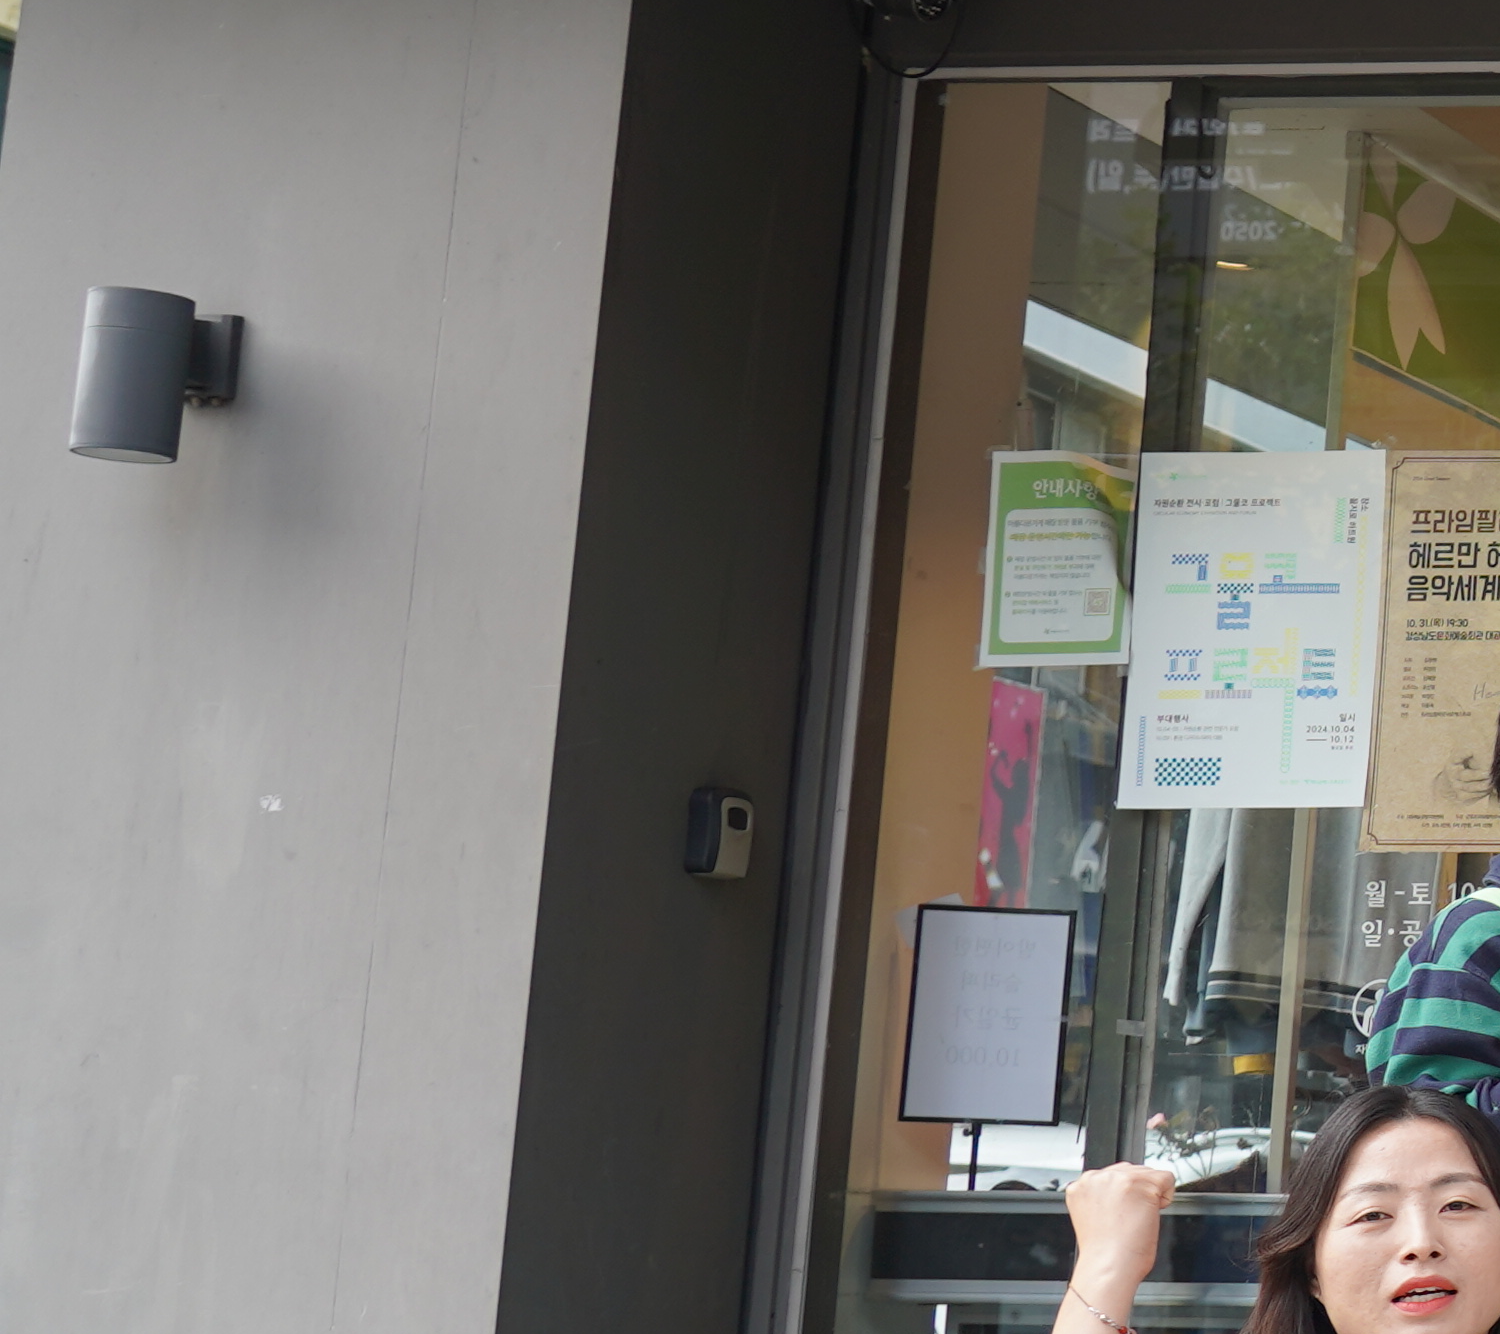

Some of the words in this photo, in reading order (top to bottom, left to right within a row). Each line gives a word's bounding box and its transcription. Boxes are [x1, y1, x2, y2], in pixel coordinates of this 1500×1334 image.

[1032, 477, 1099, 501] 안내사항
[1408, 540, 1481, 569] 헤르만
[1156, 714, 1190, 724] 부대행사
[1338, 713, 1356, 723] 일시
[1305, 725, 1355, 734] 2024.10.04
[1329, 735, 1355, 744] 10.12
